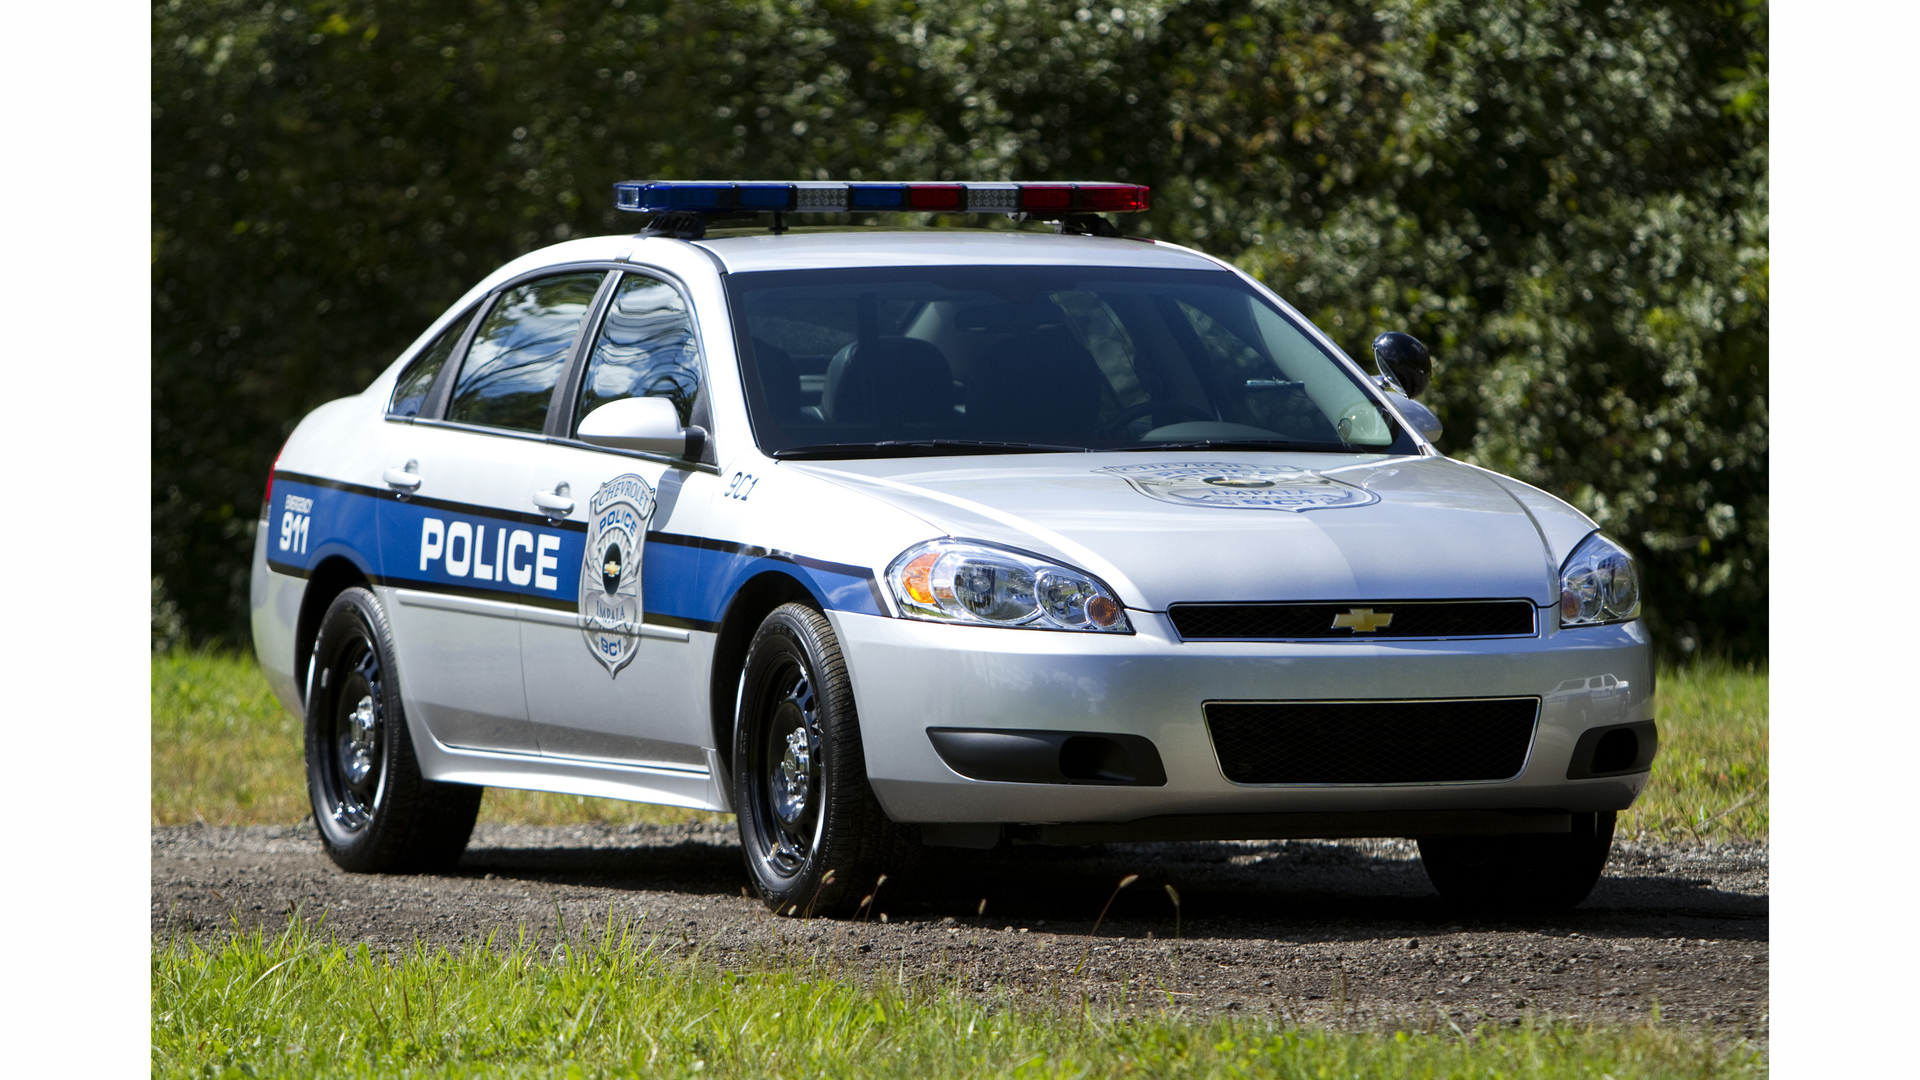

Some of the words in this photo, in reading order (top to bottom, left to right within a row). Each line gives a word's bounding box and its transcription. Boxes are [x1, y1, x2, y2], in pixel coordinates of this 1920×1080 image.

[598, 481, 649, 511] CHEVROLET
[723, 471, 759, 501] 9C1
[279, 511, 310, 555] 911
[599, 509, 637, 537] POLICE
[419, 517, 561, 591] POLICE
[596, 599, 626, 622] IMPALA
[601, 636, 622, 657] 9C1
